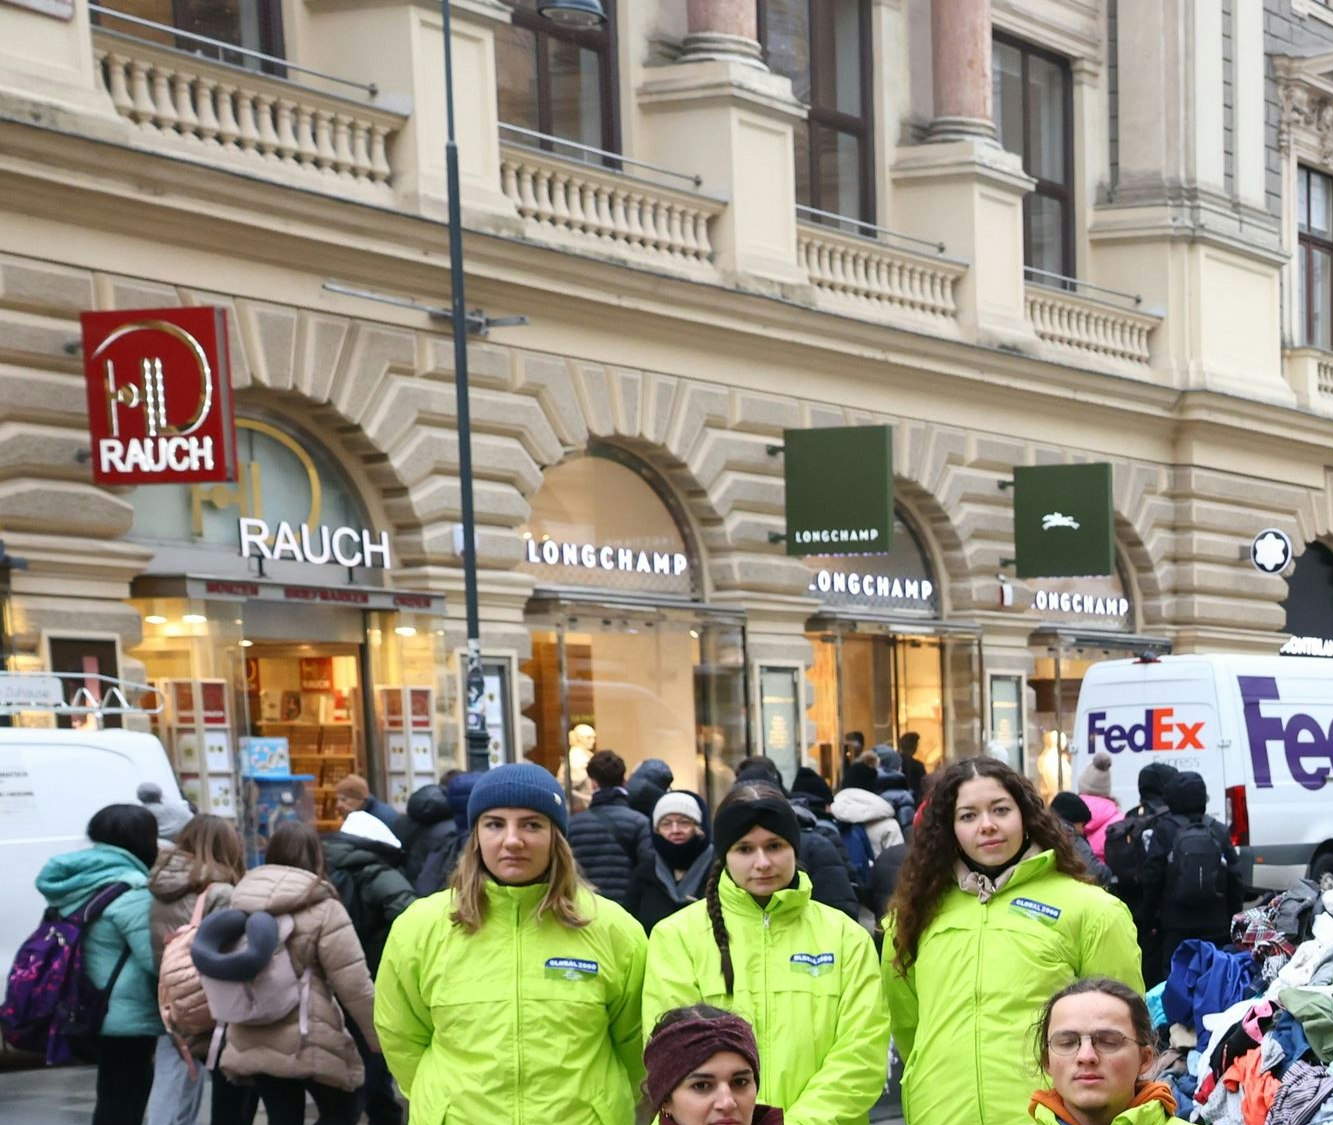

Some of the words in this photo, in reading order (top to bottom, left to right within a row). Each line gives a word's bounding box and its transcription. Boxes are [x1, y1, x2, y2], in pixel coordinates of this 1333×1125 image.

[101, 436, 214, 473] RAUCH
[239, 517, 391, 569] RAUCH
[795, 528, 879, 543] LONGCHAMP
[528, 539, 687, 576] LONGCHAMP
[1031, 590, 1128, 617] ONGCHAMP
[1088, 707, 1206, 754] FedEx
[1016, 899, 1040, 910] GLOBAL
[1040, 905, 1059, 917] 2000
[549, 959, 578, 968] GLOBAL
[578, 961, 597, 970] 2000
